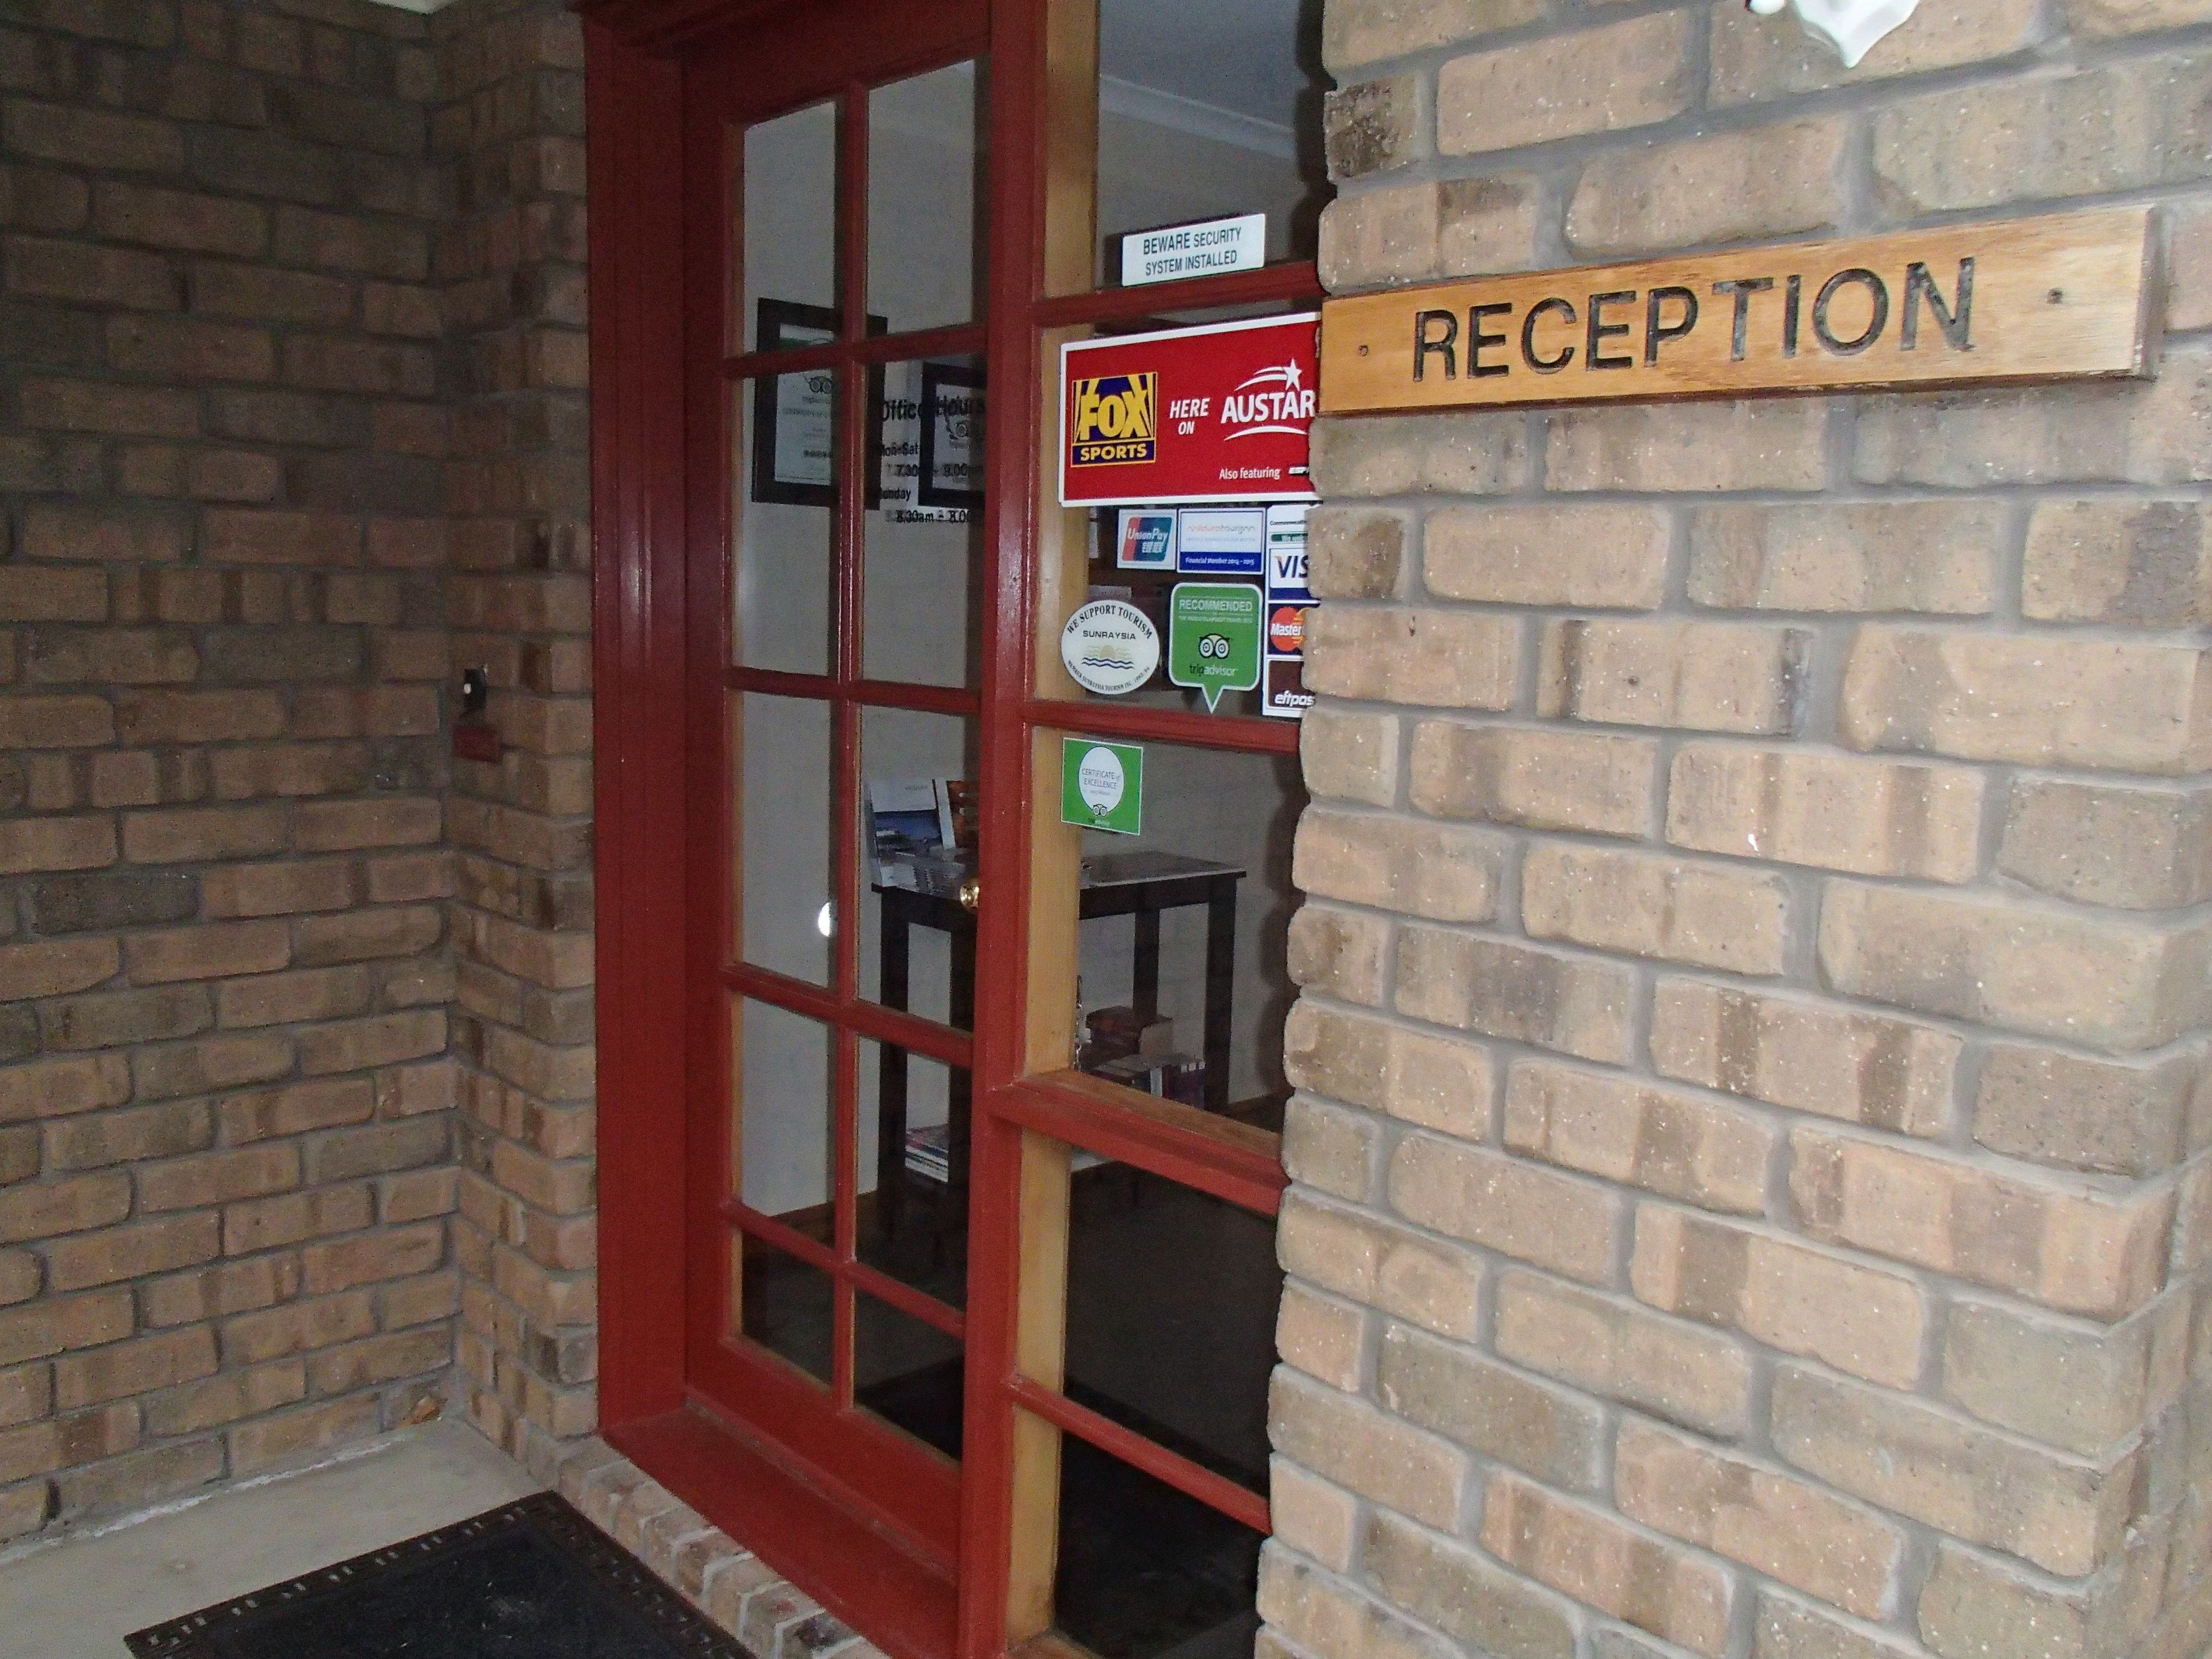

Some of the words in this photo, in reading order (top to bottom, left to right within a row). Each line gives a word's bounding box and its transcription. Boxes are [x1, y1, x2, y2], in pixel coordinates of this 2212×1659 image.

[1143, 232, 1191, 255] BEWARE
[1194, 227, 1241, 248] SECURITY
[1146, 258, 1182, 276] SYSTEM
[1185, 250, 1237, 270] INSTALLED
[1413, 256, 1976, 382] RECEPTION
[1080, 389, 1149, 441] FOX
[1169, 397, 1210, 419] HERE
[1221, 390, 1316, 424] AUSTAR
[1178, 421, 1195, 435] ON
[1080, 443, 1147, 461] SPORTS
[1219, 468, 1238, 479] Also
[1240, 467, 1281, 480] featuring
[1127, 527, 1168, 542] UnionPay
[1179, 599, 1253, 612] RECOMMENDED
[1067, 619, 1079, 634] WE
[1080, 605, 1116, 623] SUPPORT
[1118, 607, 1152, 639] TOURISM
[1083, 630, 1136, 640] SUNRAYSIA
[1069, 660, 1082, 678] MEMBER
[1189, 663, 1237, 676] tripadvisor
[1274, 690, 1316, 707] eftpos
[1082, 768, 1115, 779] CERTIFICATE
[1084, 778, 1117, 789] EXCELLENCE
